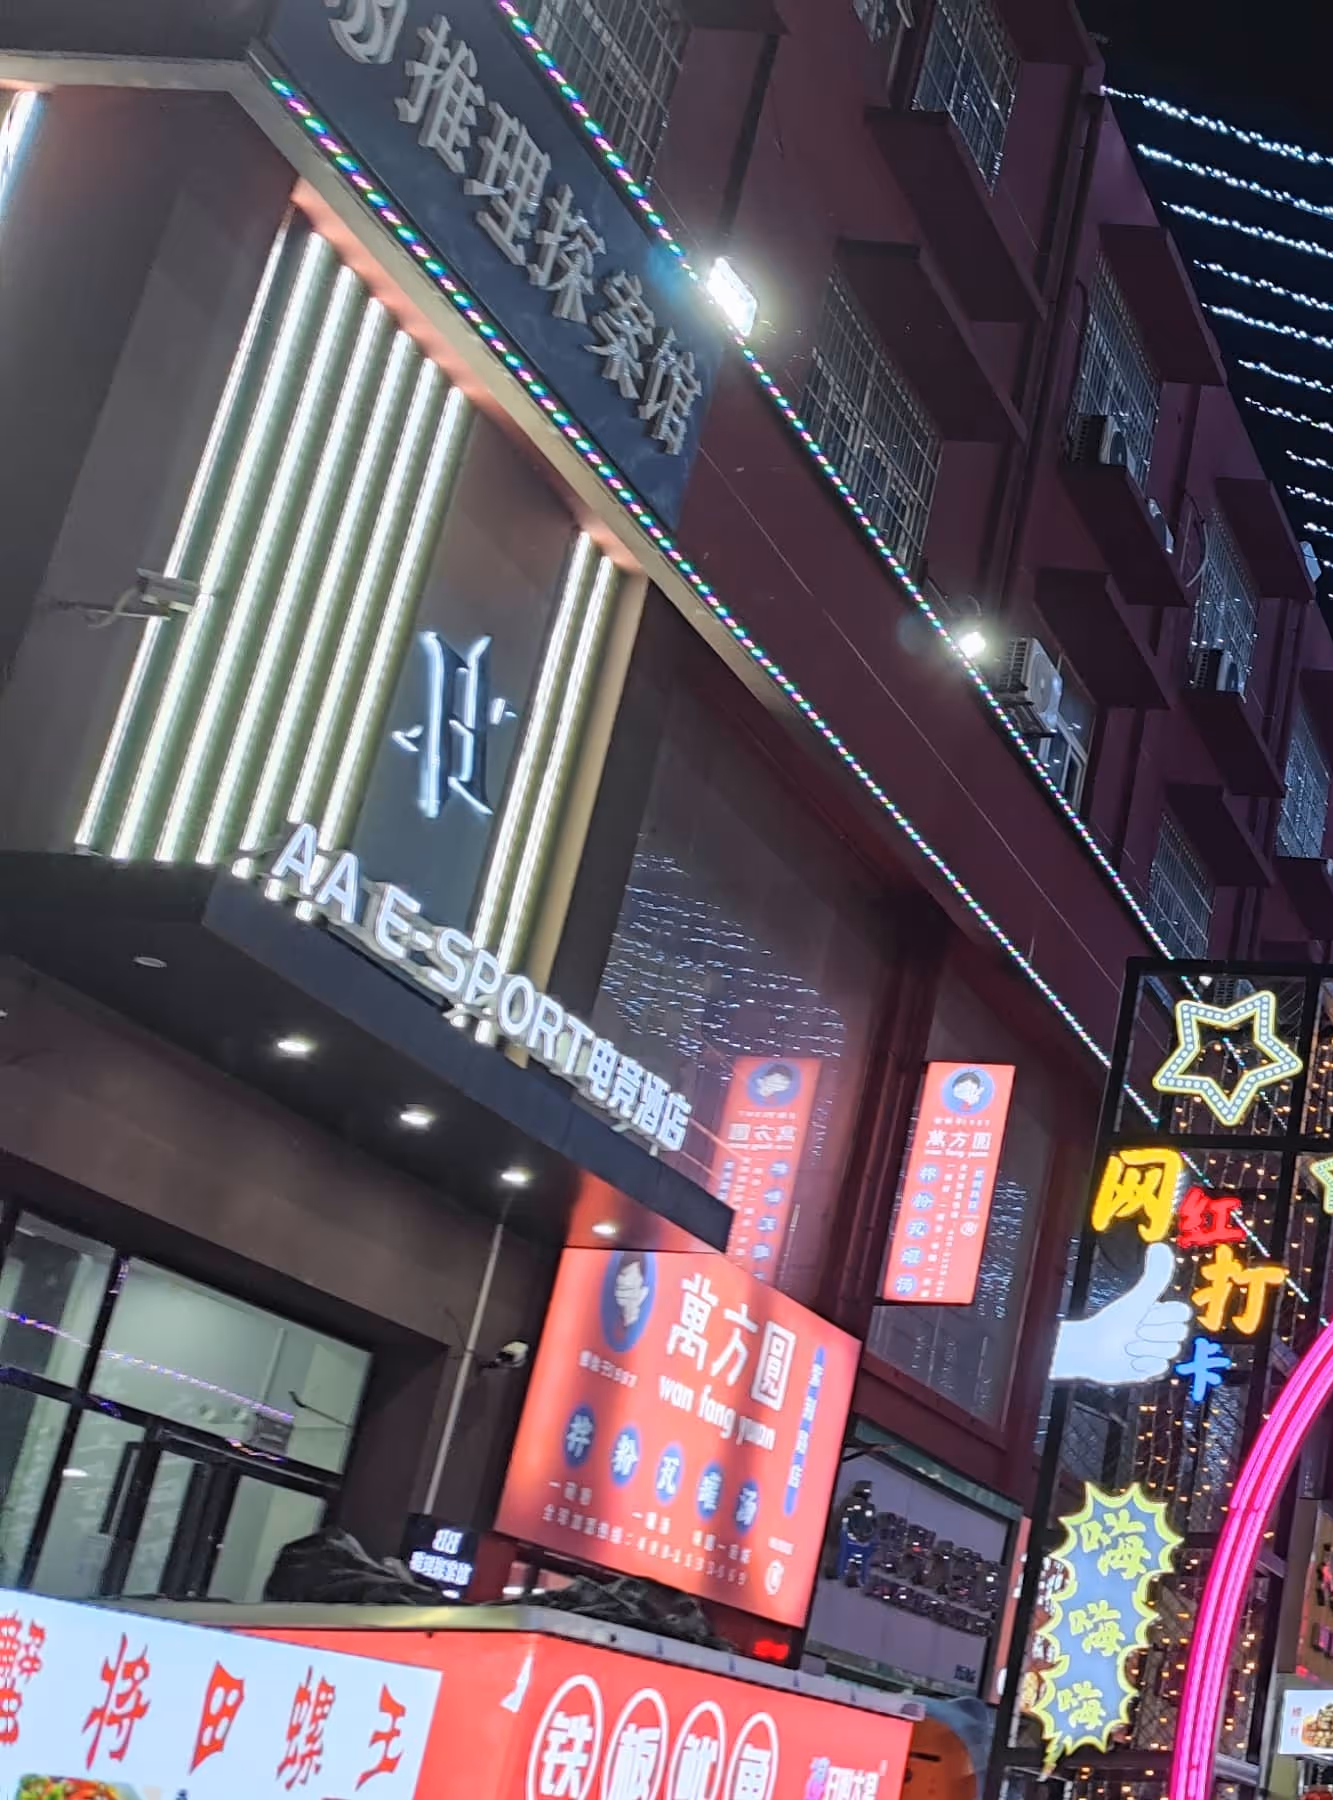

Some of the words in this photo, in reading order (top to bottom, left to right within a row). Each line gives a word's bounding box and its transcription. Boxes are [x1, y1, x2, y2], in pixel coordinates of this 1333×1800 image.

[397, 15, 706, 456] 推理探案馆
[272, 823, 361, 924] AA
[374, 883, 594, 1076] E-SPORT
[584, 1036, 692, 1153] 电竞酒店
[658, 1374, 695, 1412] wan
[1090, 1146, 1288, 1402] 网红打卡
[1057, 1508, 1152, 1731] 嗨嗨嗨
